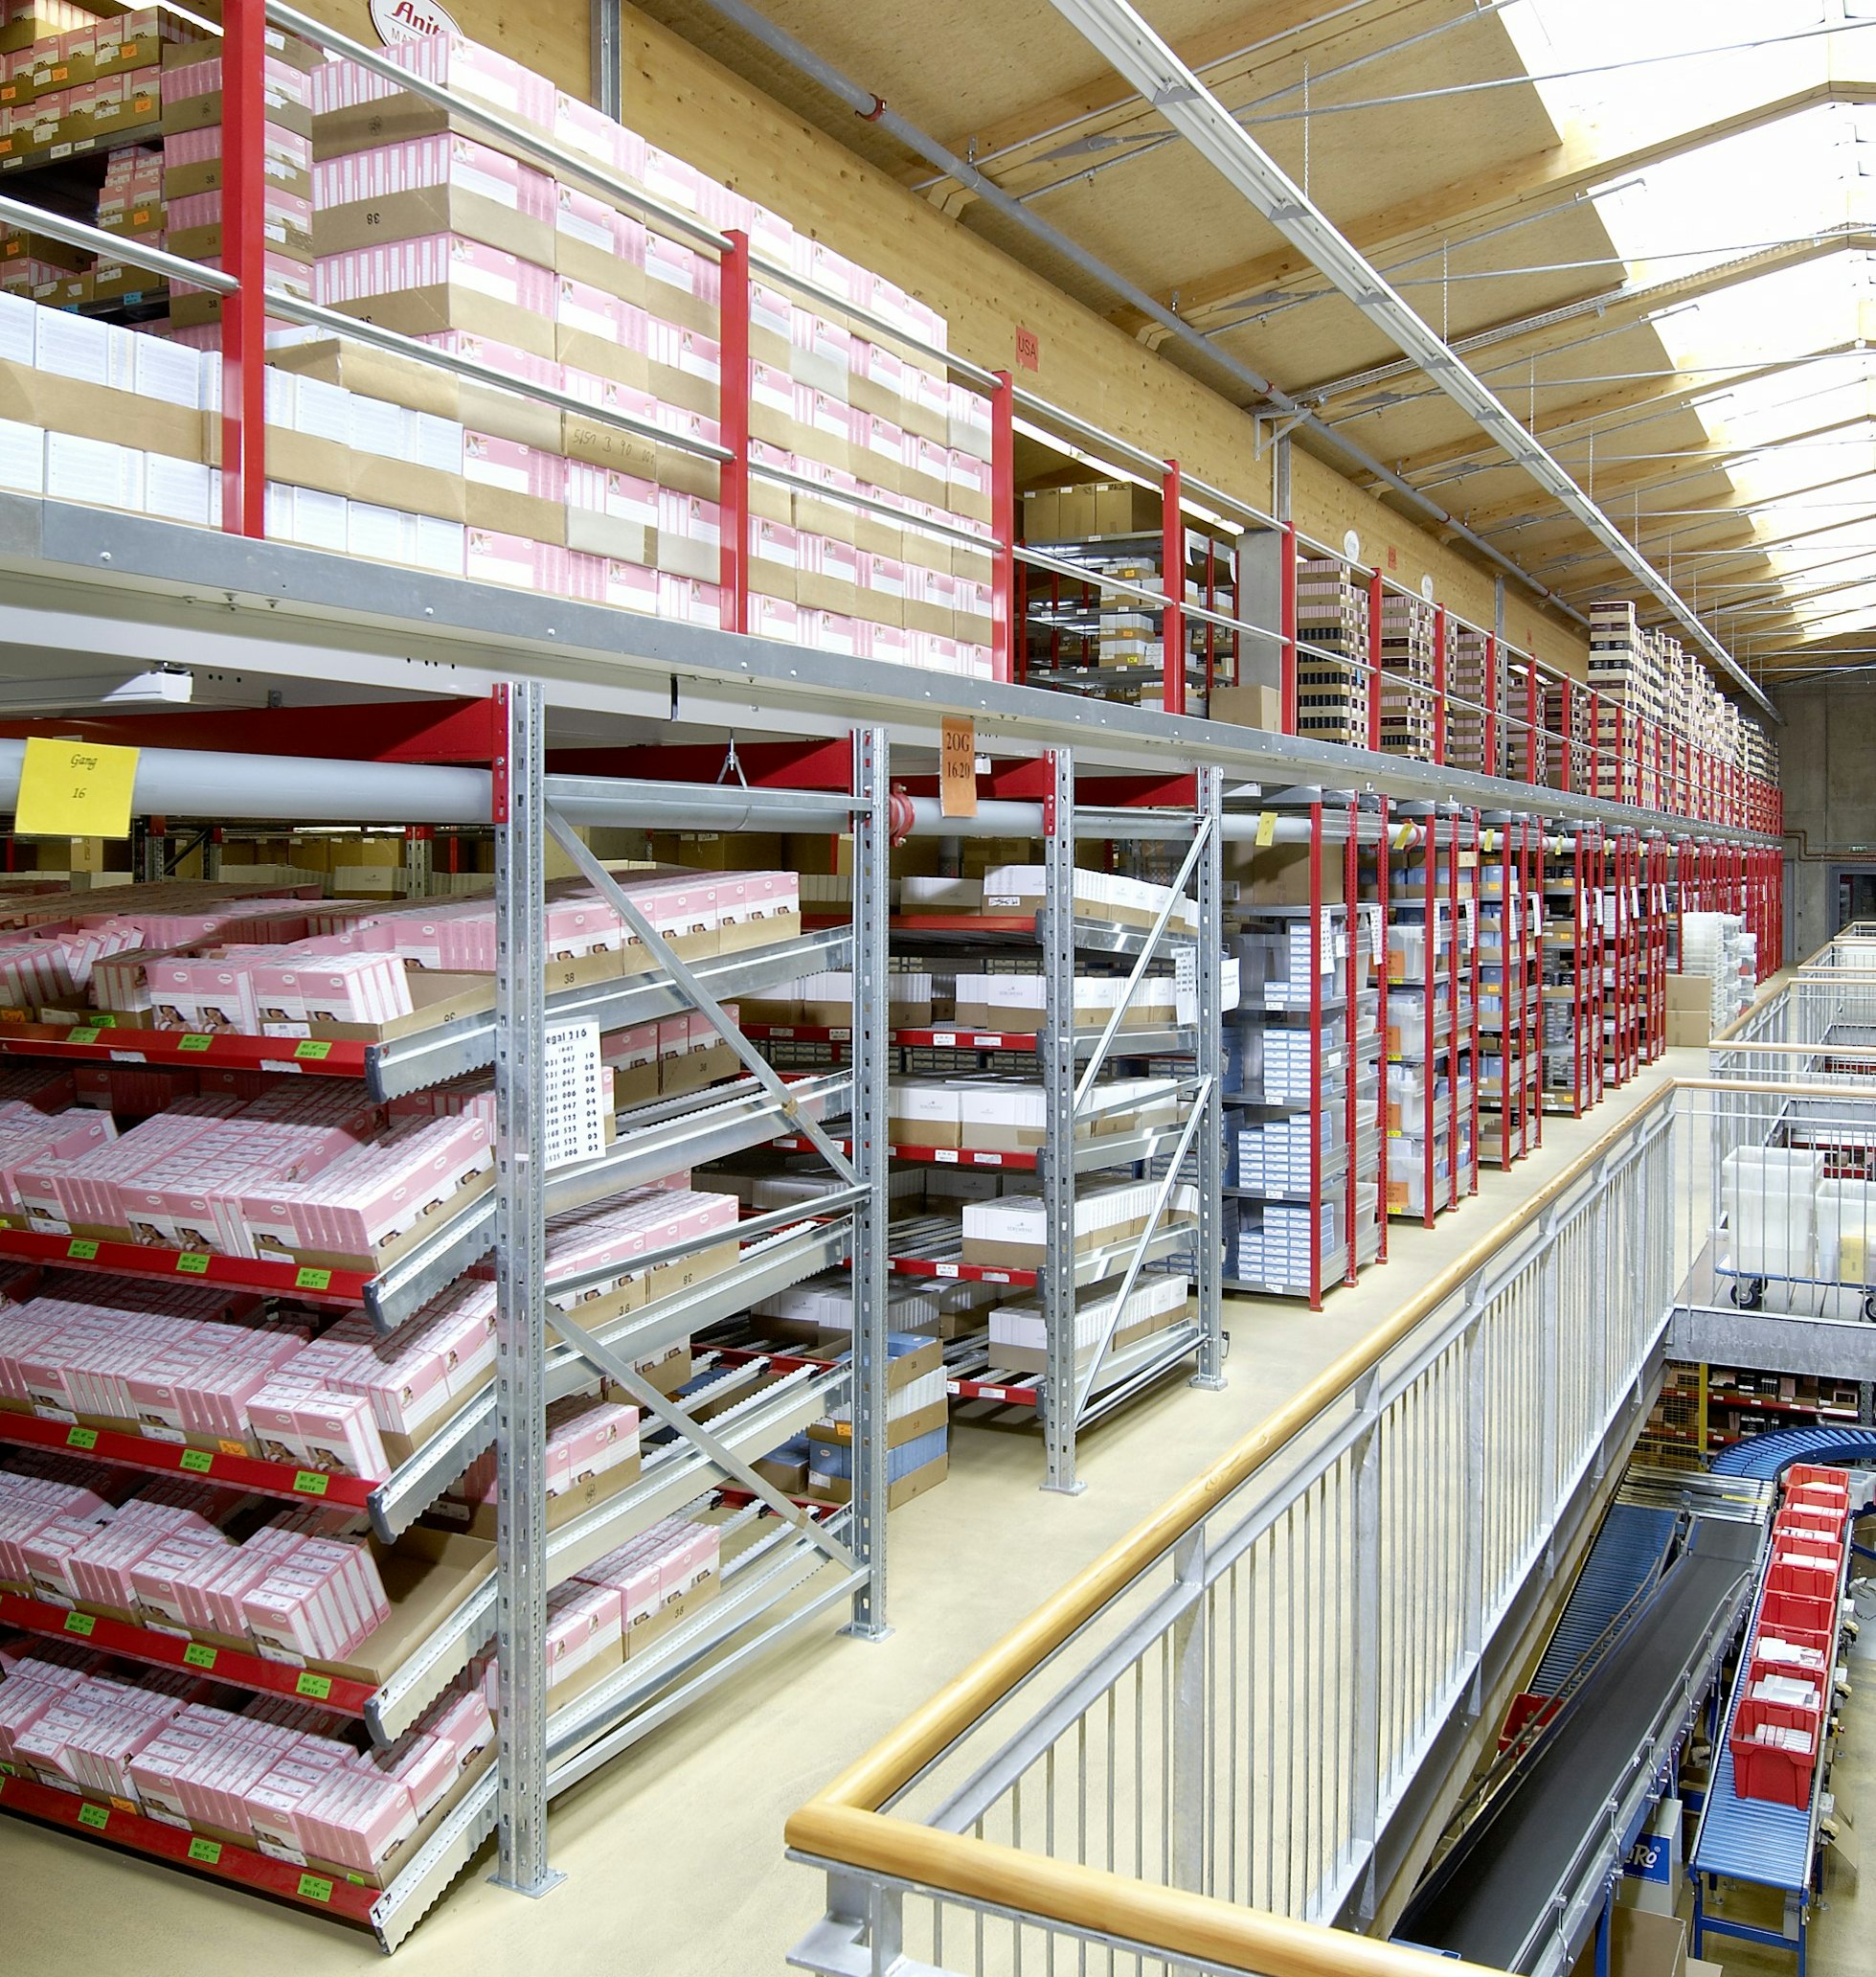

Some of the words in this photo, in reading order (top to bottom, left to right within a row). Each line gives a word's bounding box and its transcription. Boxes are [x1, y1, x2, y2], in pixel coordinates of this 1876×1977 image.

[392, 1, 444, 35] Anit
[1018, 335, 1037, 361] USA
[70, 754, 98, 771] Gang
[72, 787, 87, 799] 16
[564, 972, 575, 985] 38
[546, 1032, 566, 1045] egal
[569, 1028, 587, 1040] 216
[683, 1272, 693, 1284] 38
[619, 1304, 631, 1316] 38
